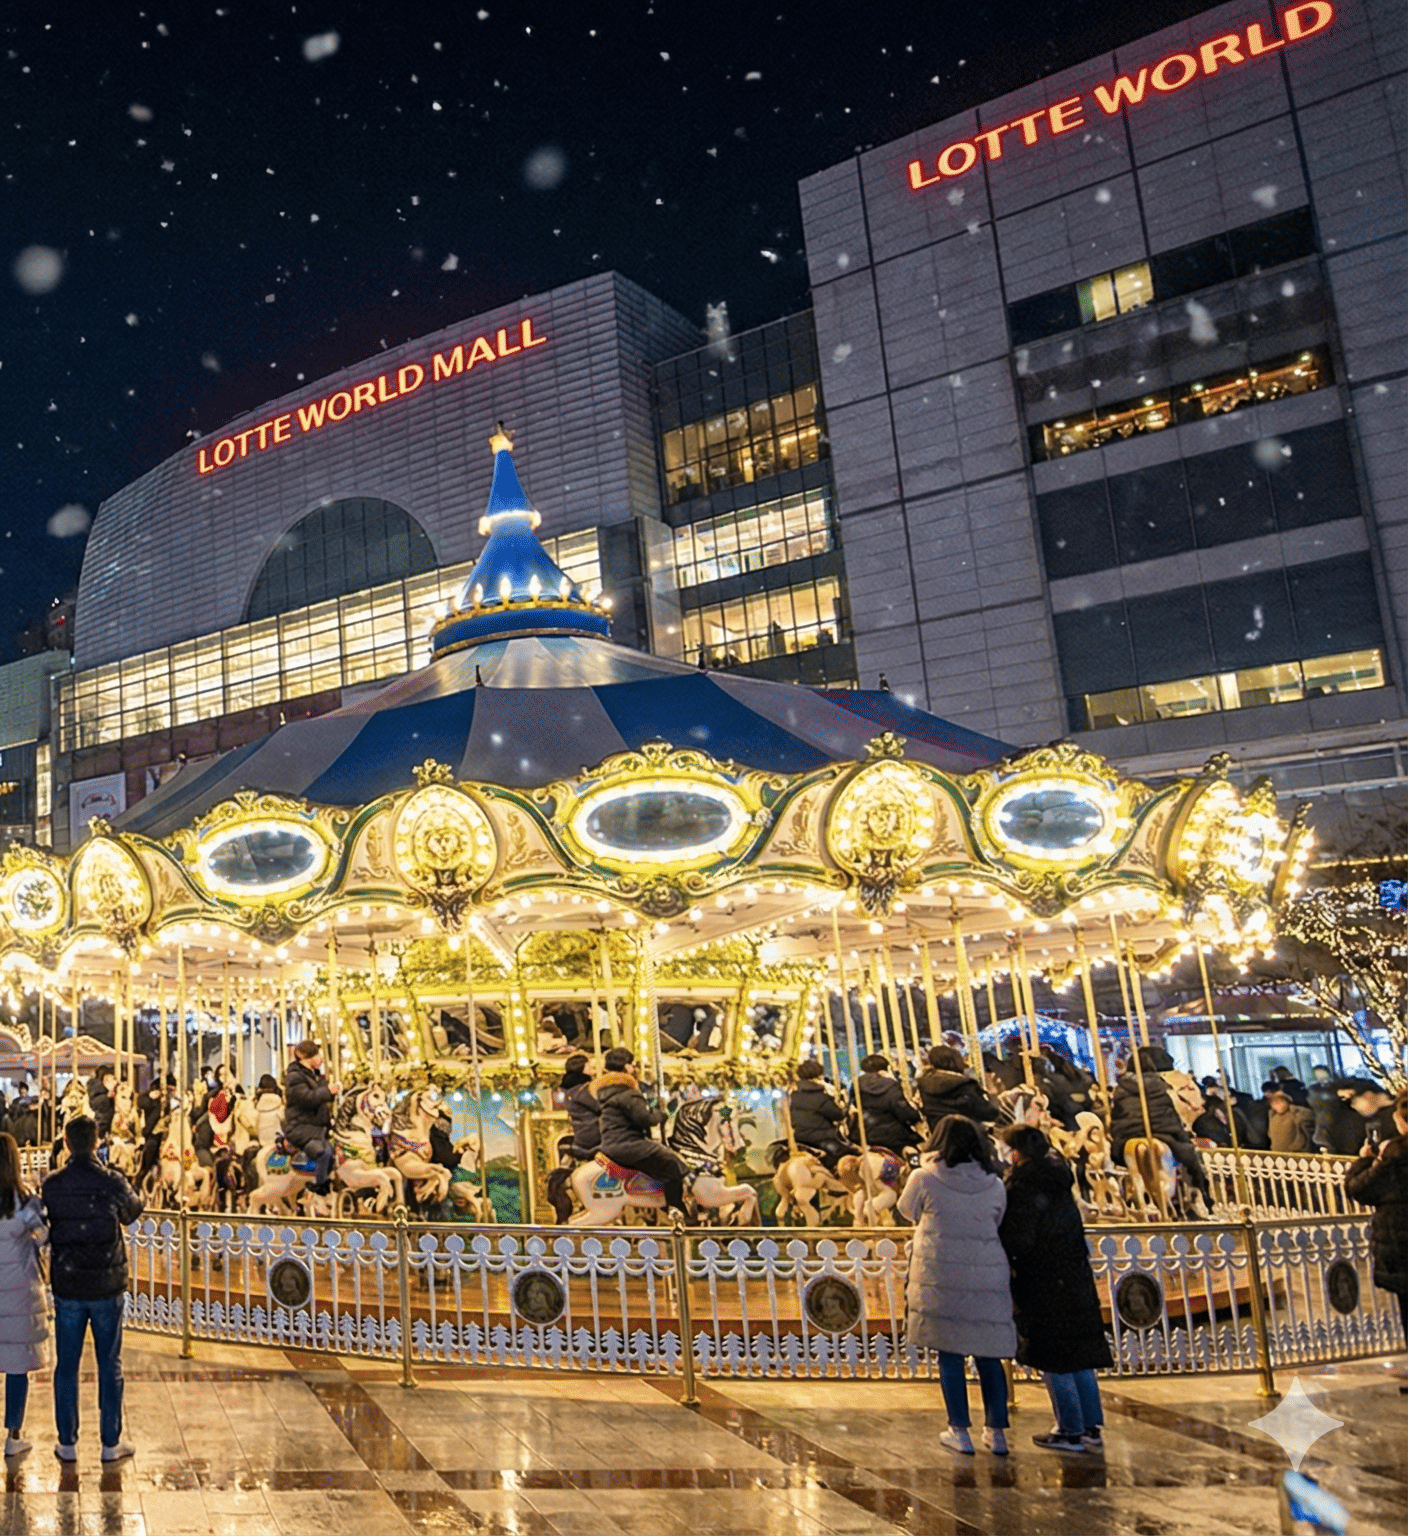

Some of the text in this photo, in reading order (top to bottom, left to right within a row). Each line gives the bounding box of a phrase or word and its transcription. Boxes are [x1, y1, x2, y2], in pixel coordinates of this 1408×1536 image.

[907, 0, 1334, 190] LOTTE WORLD
[197, 318, 548, 475] LOTTE WORLD MALL
